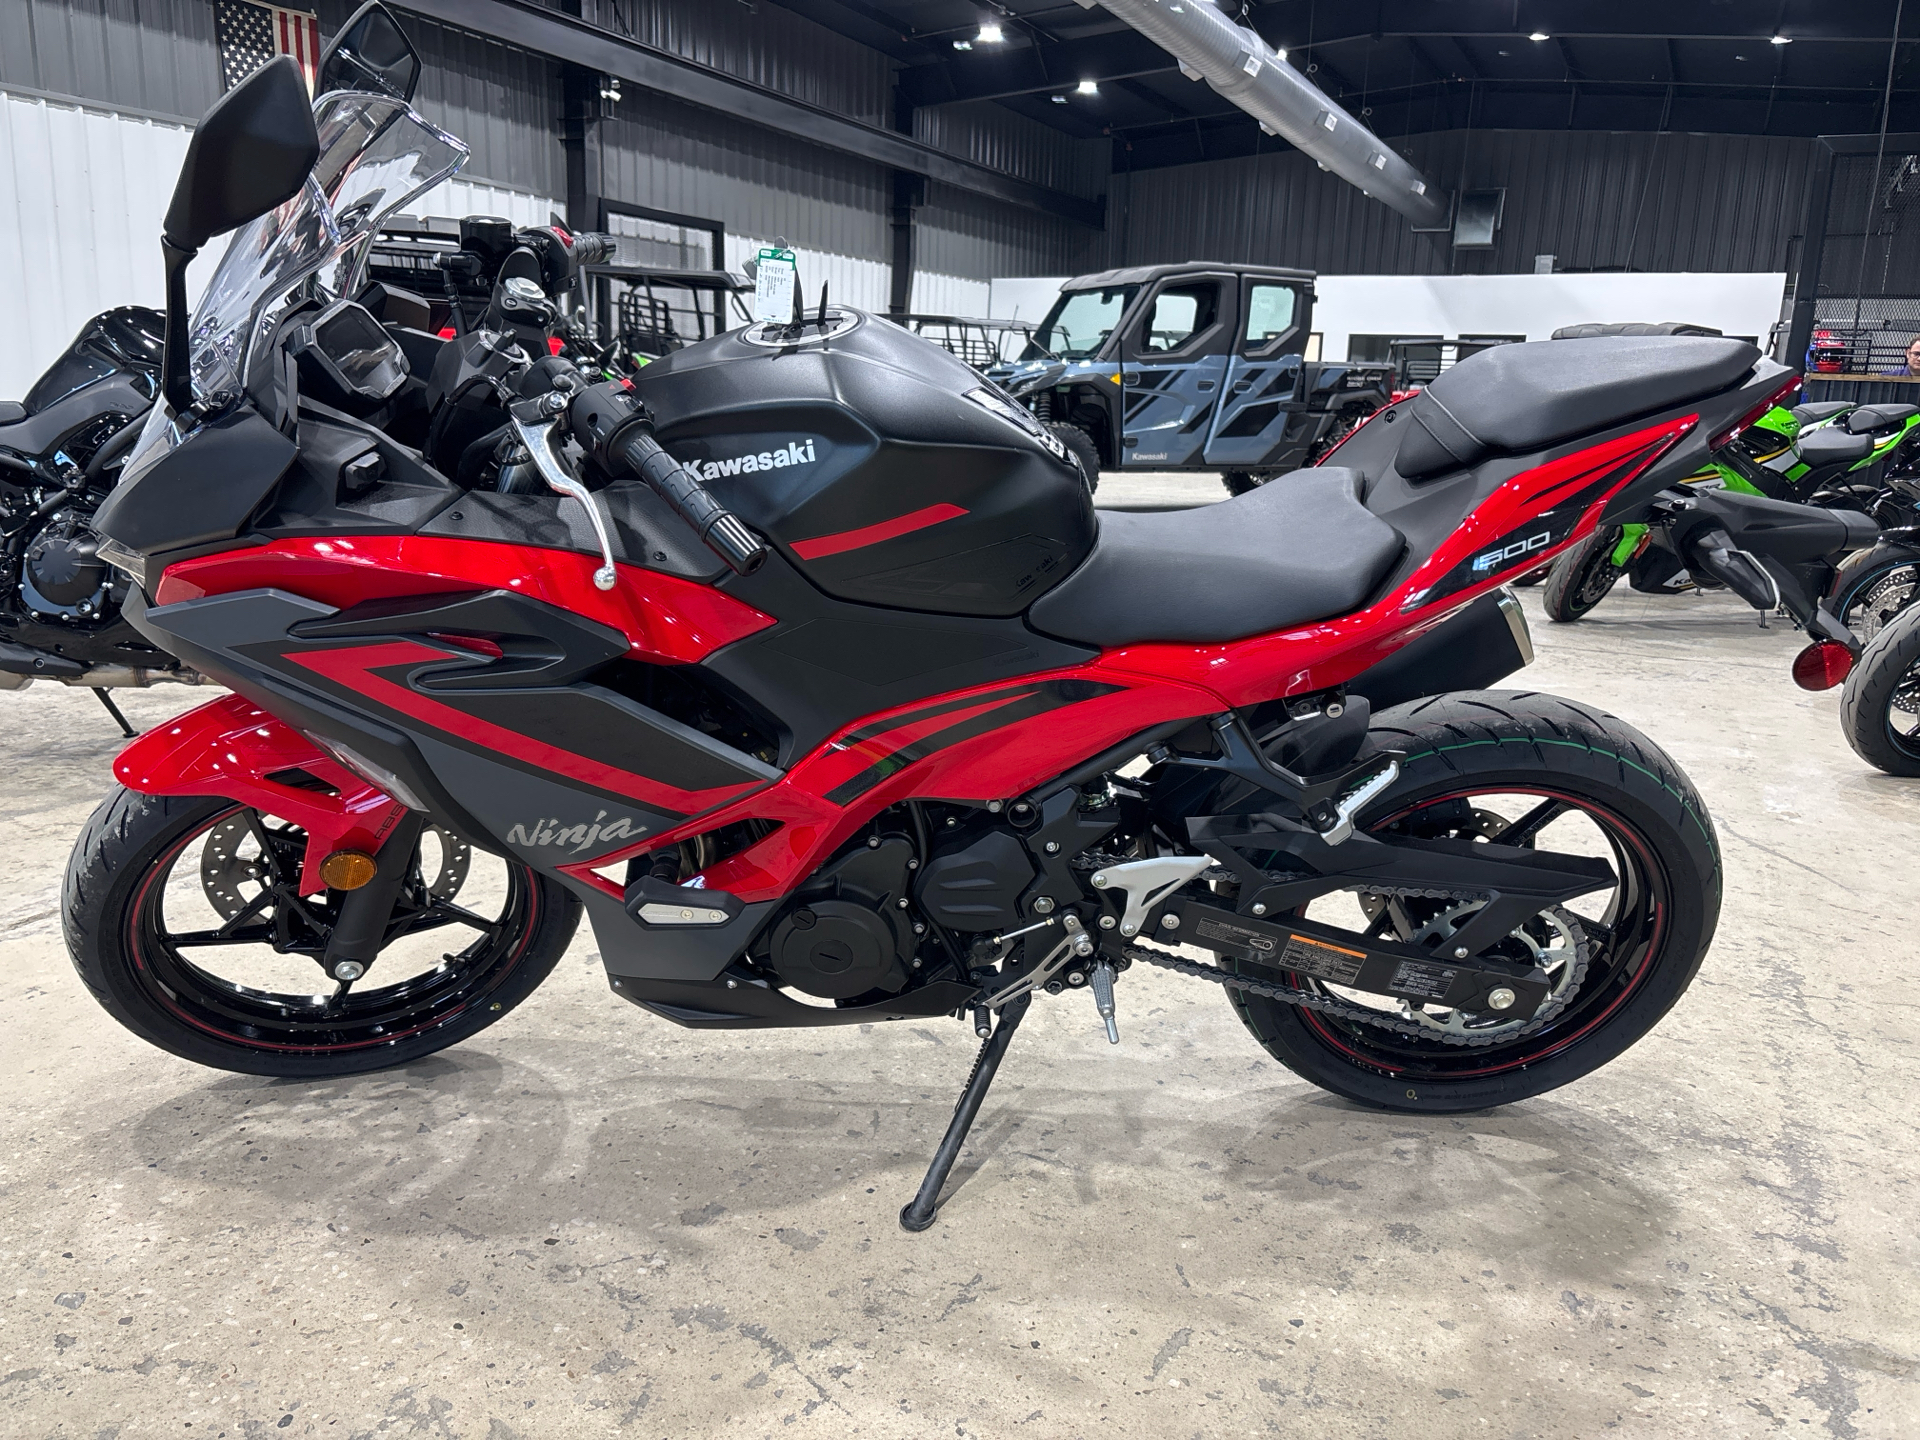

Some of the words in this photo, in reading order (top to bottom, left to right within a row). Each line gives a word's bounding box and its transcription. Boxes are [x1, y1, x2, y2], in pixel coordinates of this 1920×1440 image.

[683, 438, 816, 482] Kawasaki
[1132, 452, 1168, 461] Kawasaki
[1478, 531, 1551, 568] 500
[374, 803, 404, 841] ABS
[506, 809, 648, 857] Ninja
